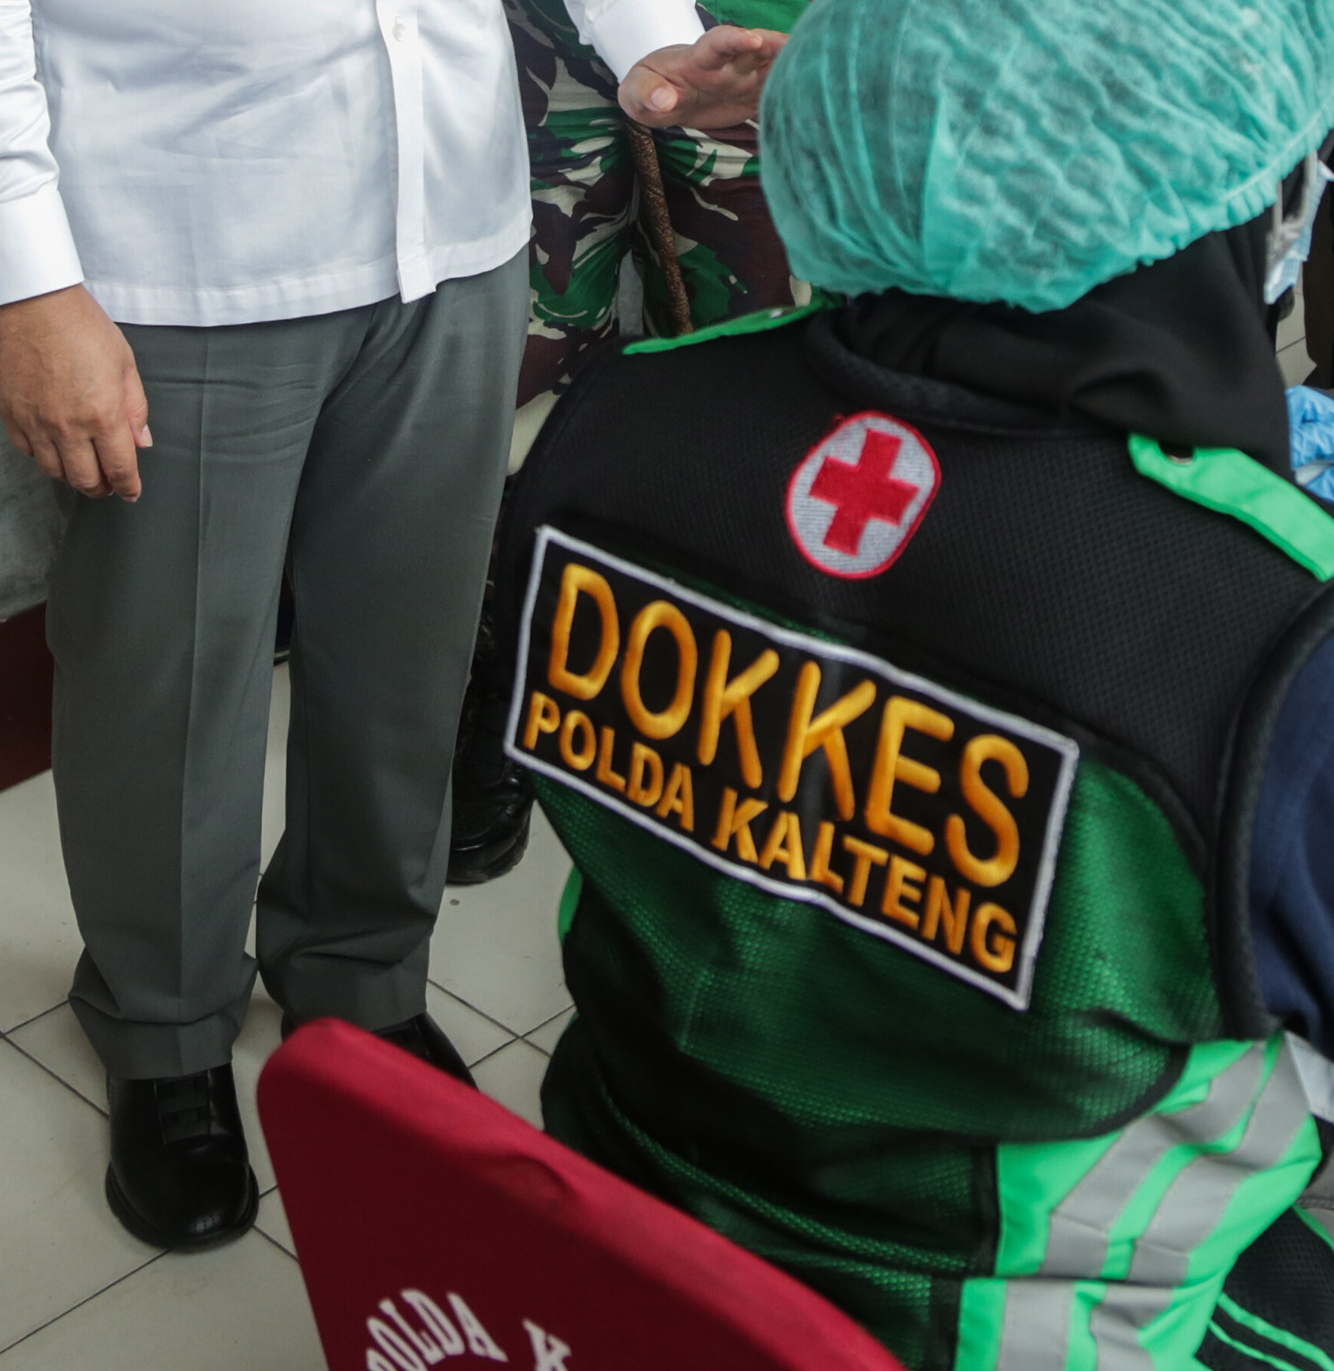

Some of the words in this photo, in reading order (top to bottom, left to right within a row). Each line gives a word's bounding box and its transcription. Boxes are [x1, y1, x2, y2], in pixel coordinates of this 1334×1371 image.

[523, 690, 695, 832] POLDA
[711, 786, 1017, 973] KALTENG
[548, 562, 1030, 888] DOKKES
